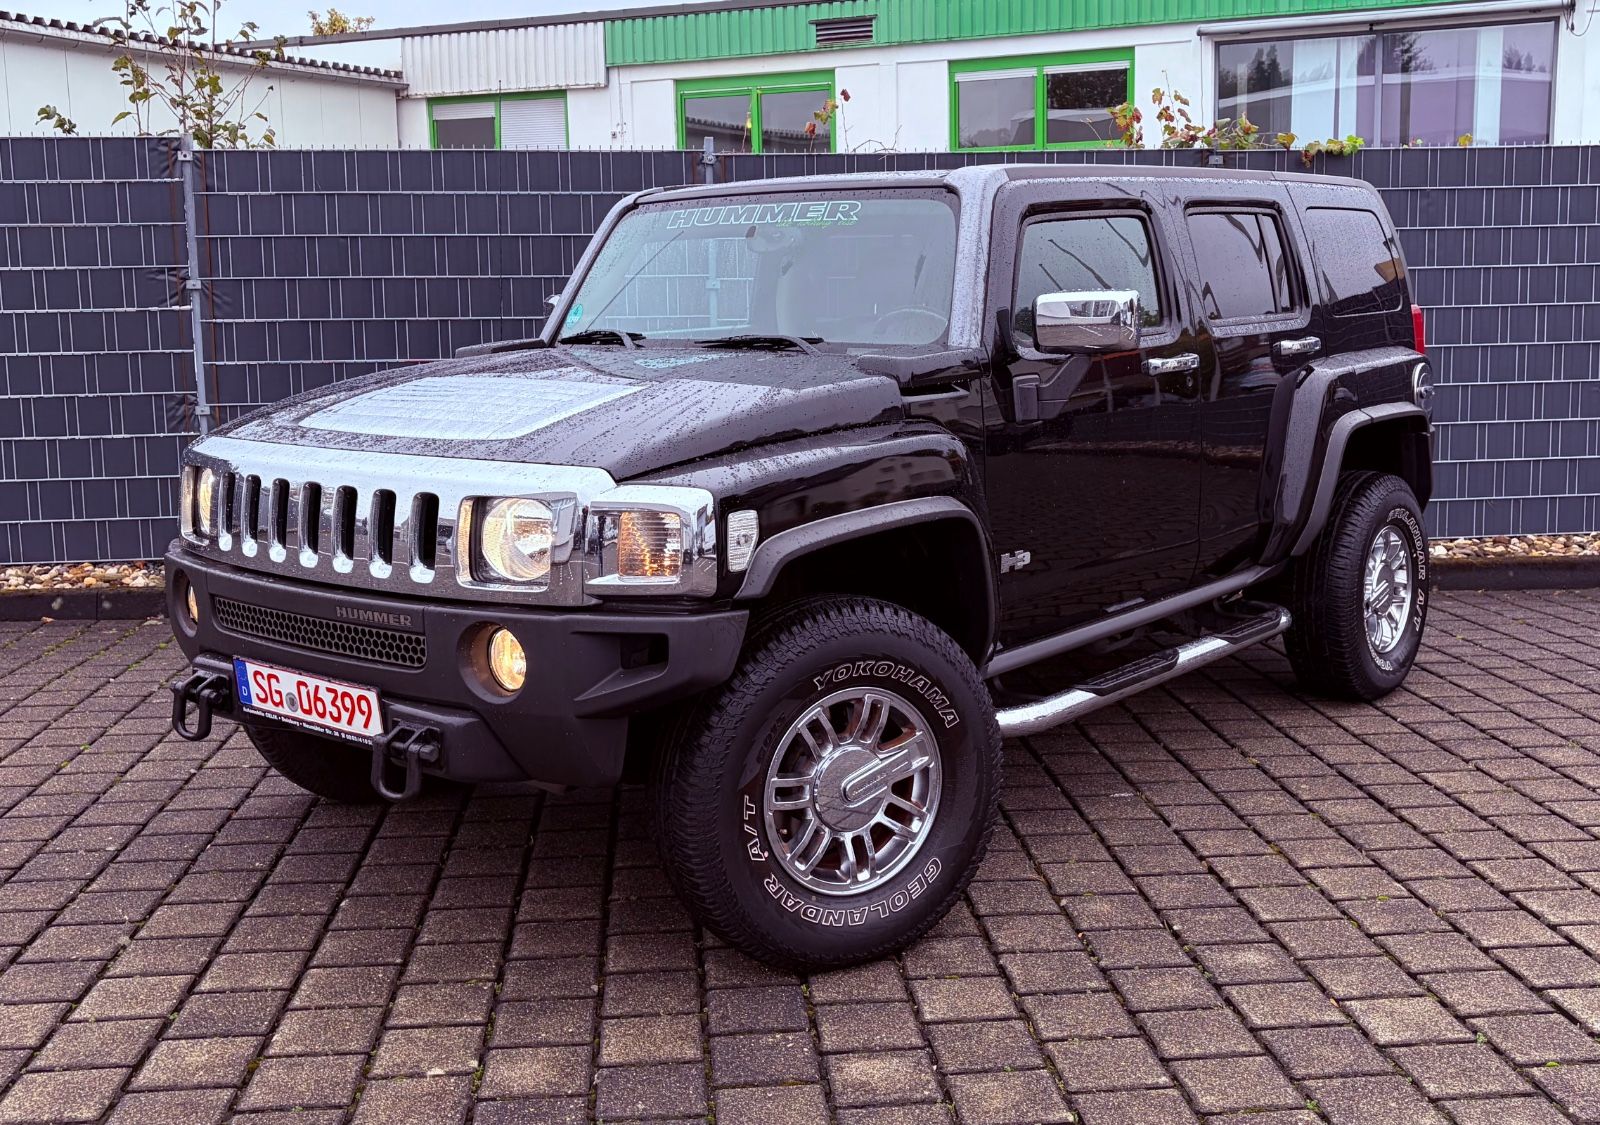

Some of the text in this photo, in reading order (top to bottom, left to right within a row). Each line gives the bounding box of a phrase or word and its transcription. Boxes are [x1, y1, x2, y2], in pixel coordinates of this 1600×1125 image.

[667, 201, 862, 229] HUMMER
[1000, 549, 1031, 574] H3
[335, 606, 411, 626] HUMMER
[242, 685, 248, 696] D
[252, 670, 372, 729] SG 06399
[813, 660, 960, 729] YOKOHAMA
[743, 795, 942, 927] GEOLANDAR A/T
